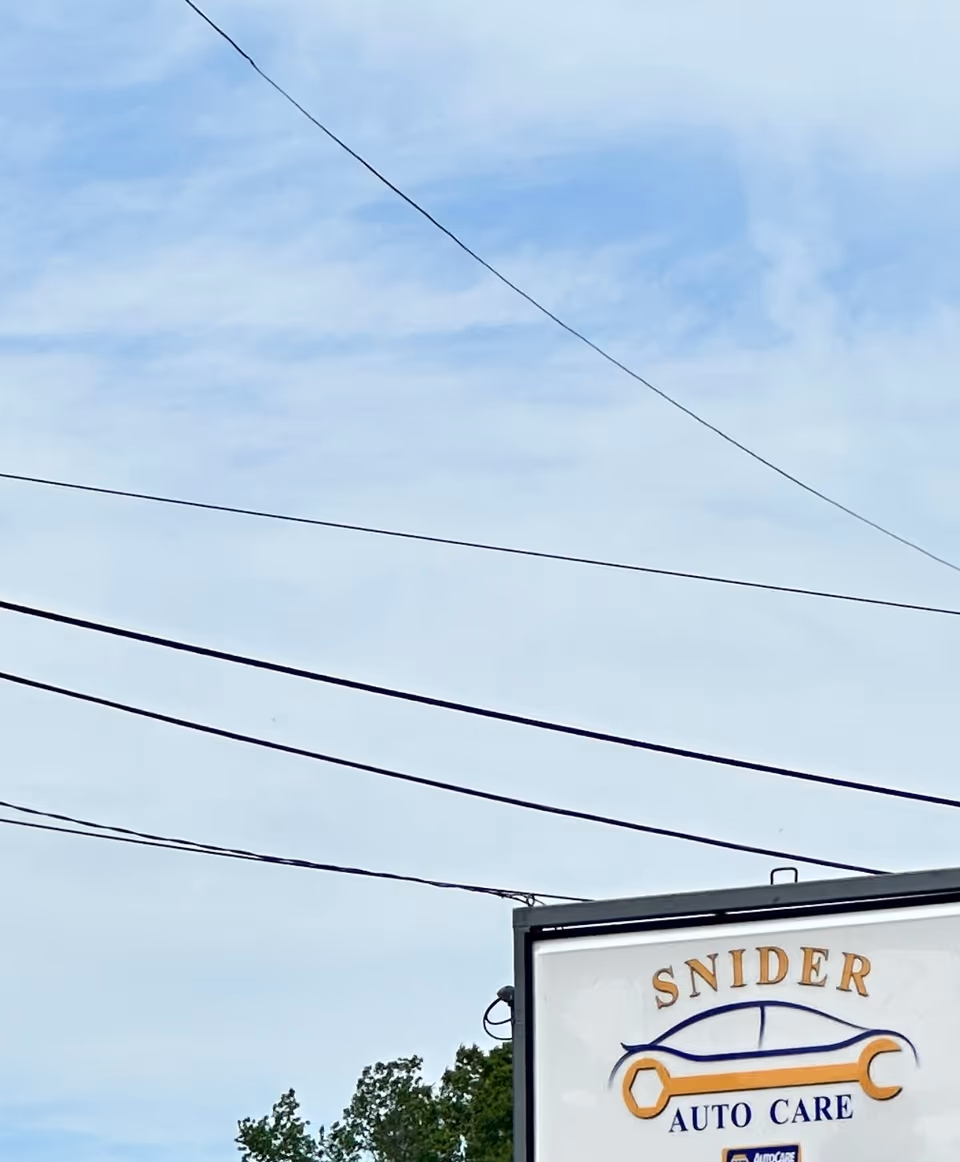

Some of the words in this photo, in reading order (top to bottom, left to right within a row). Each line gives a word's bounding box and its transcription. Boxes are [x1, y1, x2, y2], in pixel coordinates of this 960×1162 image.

[652, 946, 871, 1009] SNIDER
[668, 1102, 751, 1133] AUTO
[769, 1094, 853, 1125] CARE
